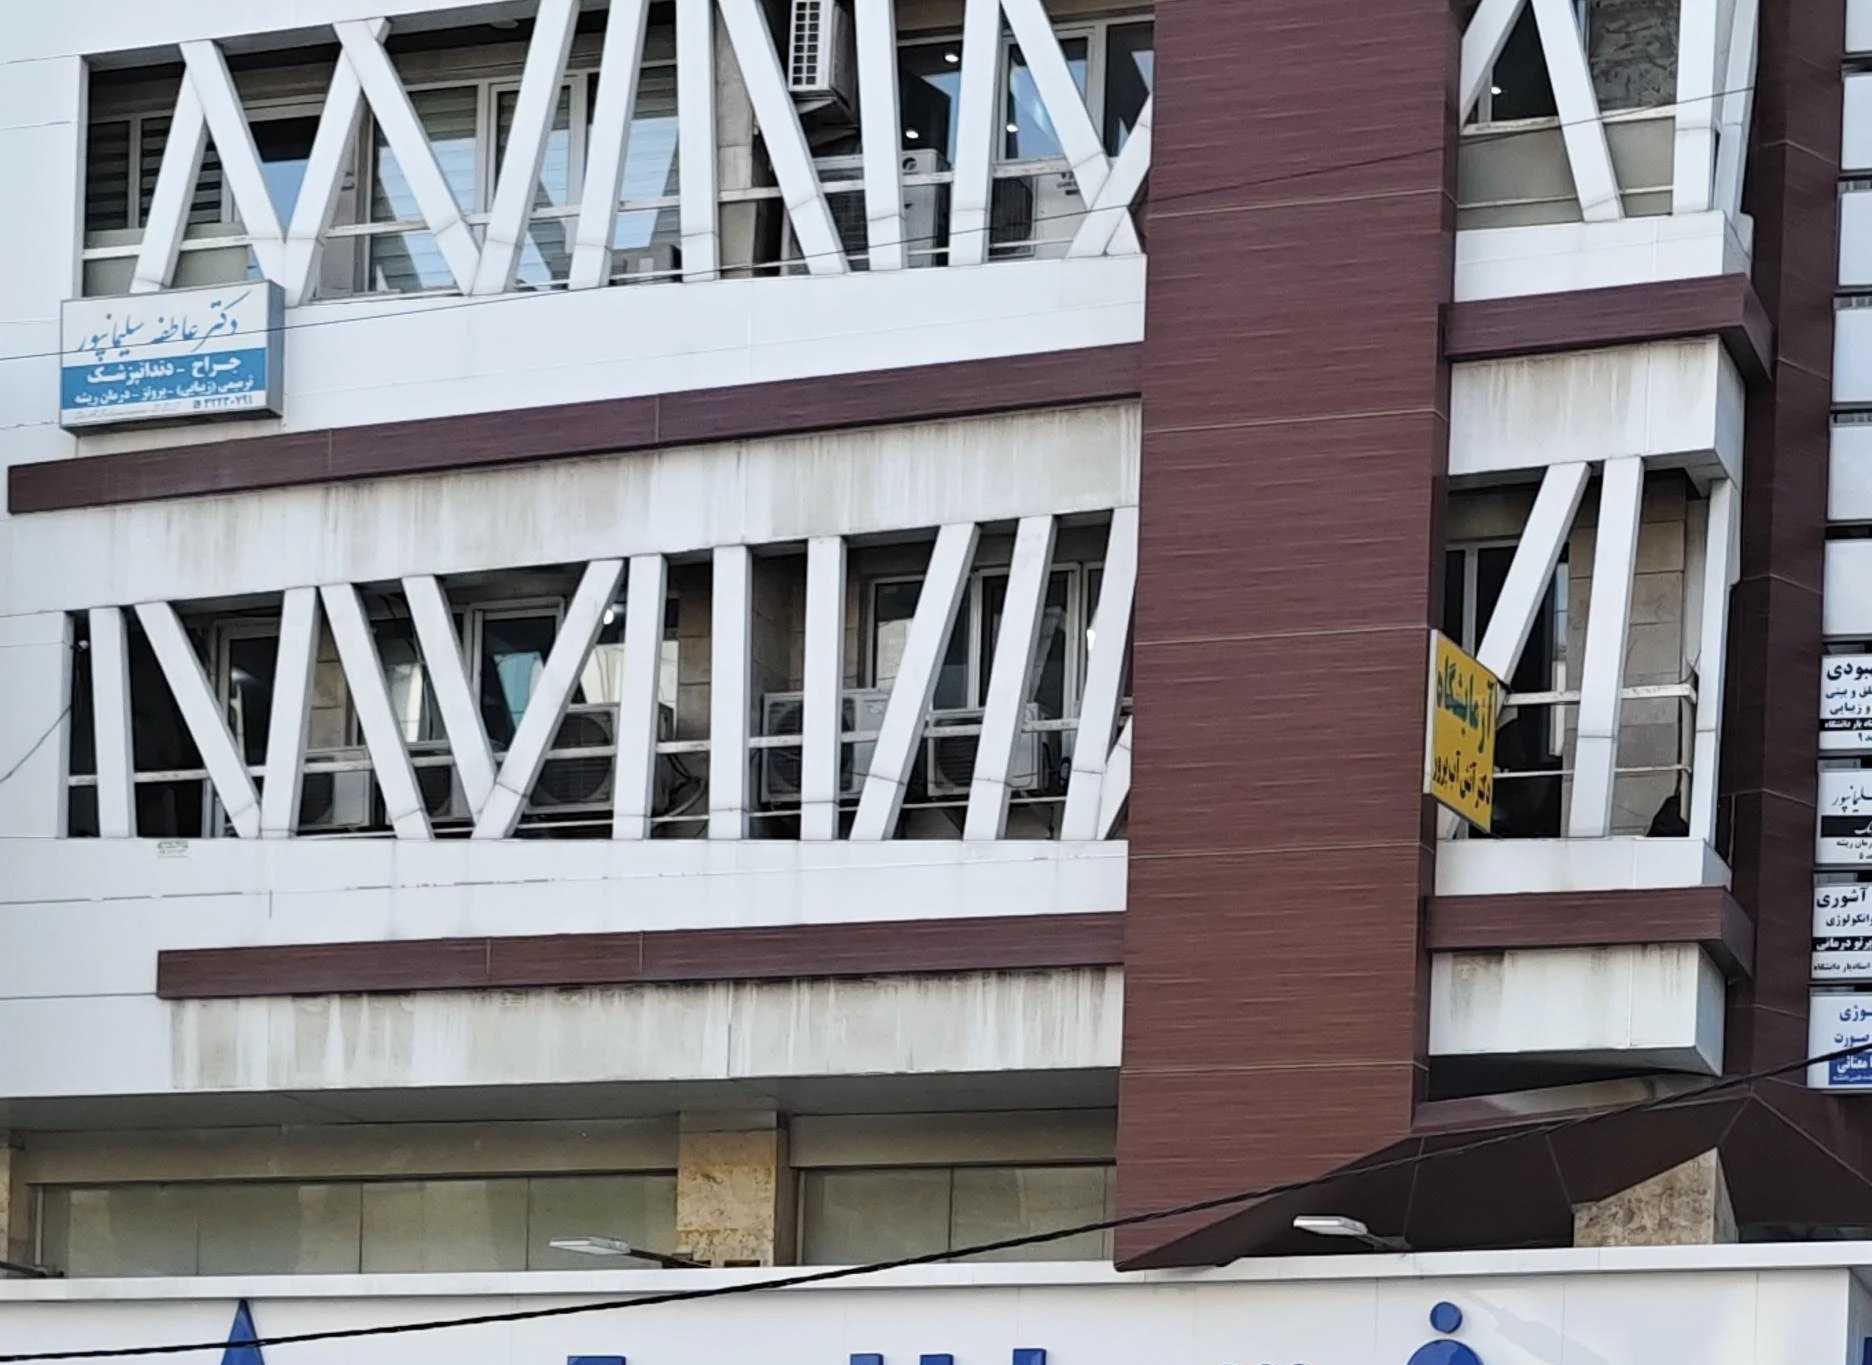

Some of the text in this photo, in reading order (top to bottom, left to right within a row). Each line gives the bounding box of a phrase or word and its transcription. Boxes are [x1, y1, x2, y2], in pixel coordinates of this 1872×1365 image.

[151, 313, 199, 345] عاطفه
[191, 289, 252, 352] دکتر
[87, 355, 242, 386] جراح دندانپزشک
[74, 392, 99, 406] ریشه
[101, 389, 130, 405] درمان
[1436, 655, 1494, 754] آزمایشگاه
[1474, 774, 1491, 809] دکتر
[1816, 887, 1869, 909] آشوری
